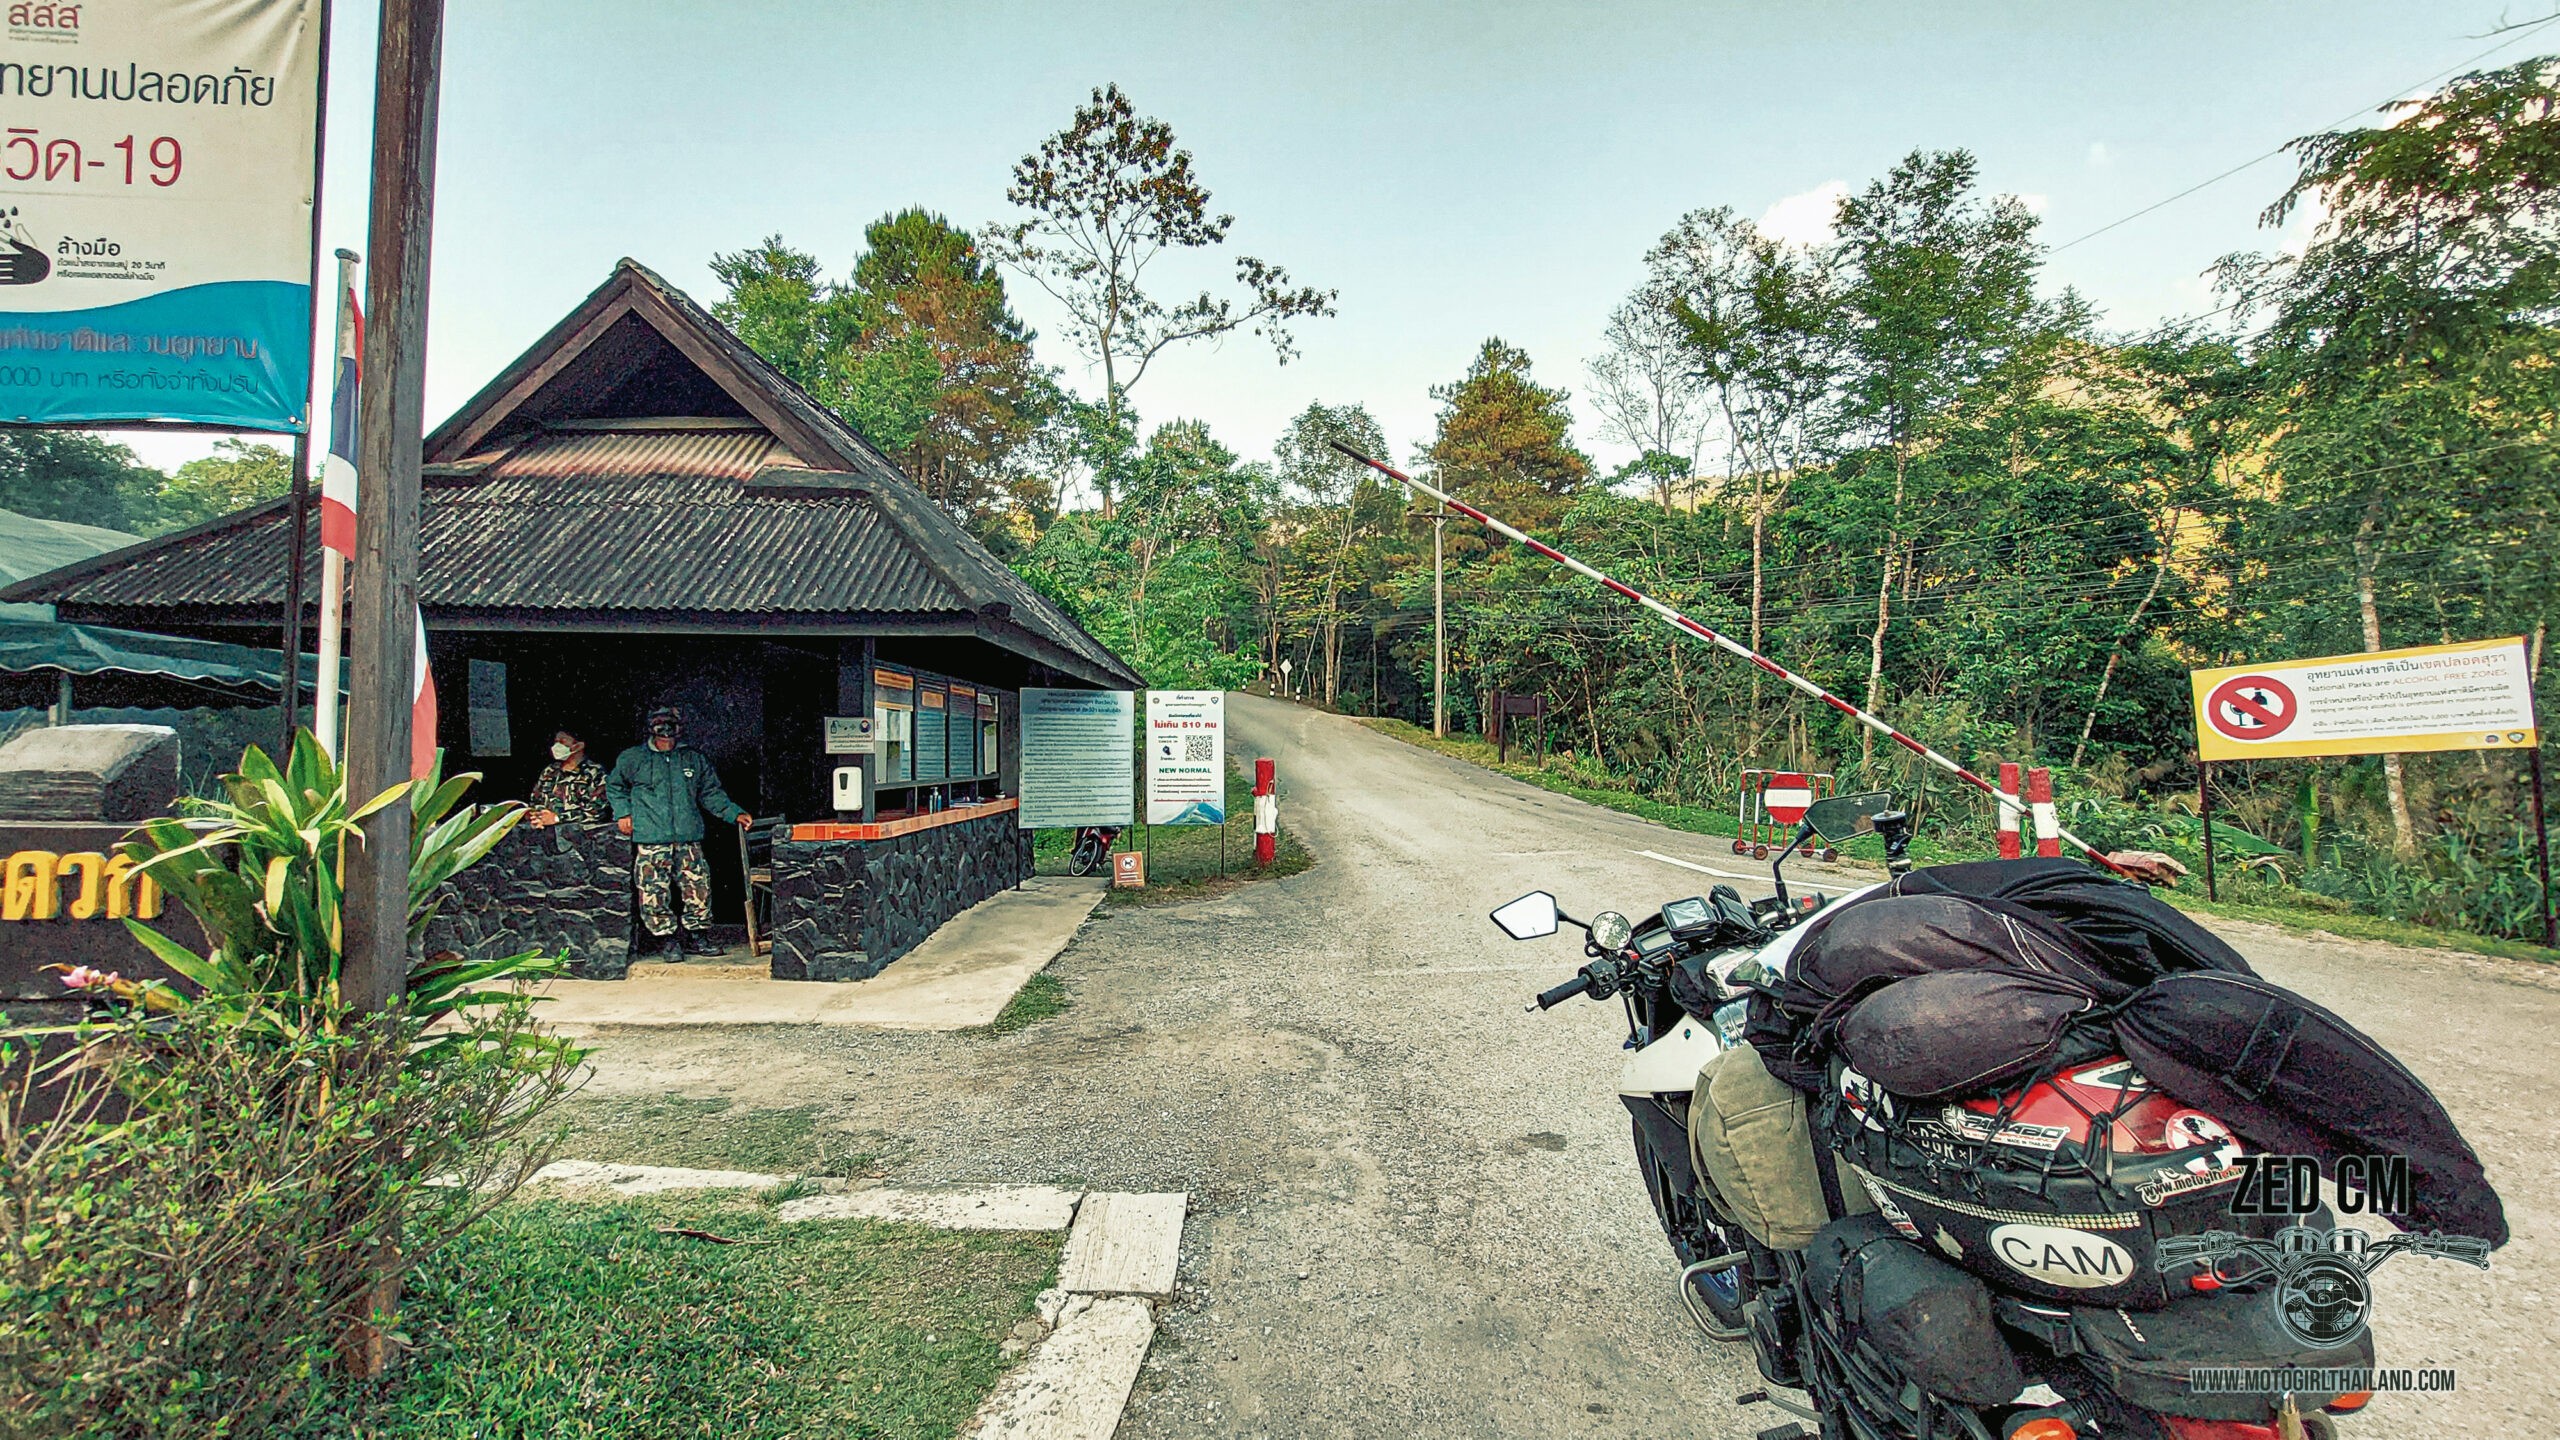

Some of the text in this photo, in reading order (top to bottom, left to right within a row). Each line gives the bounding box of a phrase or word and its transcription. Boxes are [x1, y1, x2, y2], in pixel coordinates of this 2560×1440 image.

[57, 236, 120, 256] ล้างมือ
[2308, 682, 2346, 692] National
[2348, 680, 2373, 688] Parks
[2392, 674, 2440, 685] ALCOHOL
[2443, 672, 2469, 680] FREE
[0, 850, 161, 920] ดวก
[2001, 1237, 2123, 1276] CAM
